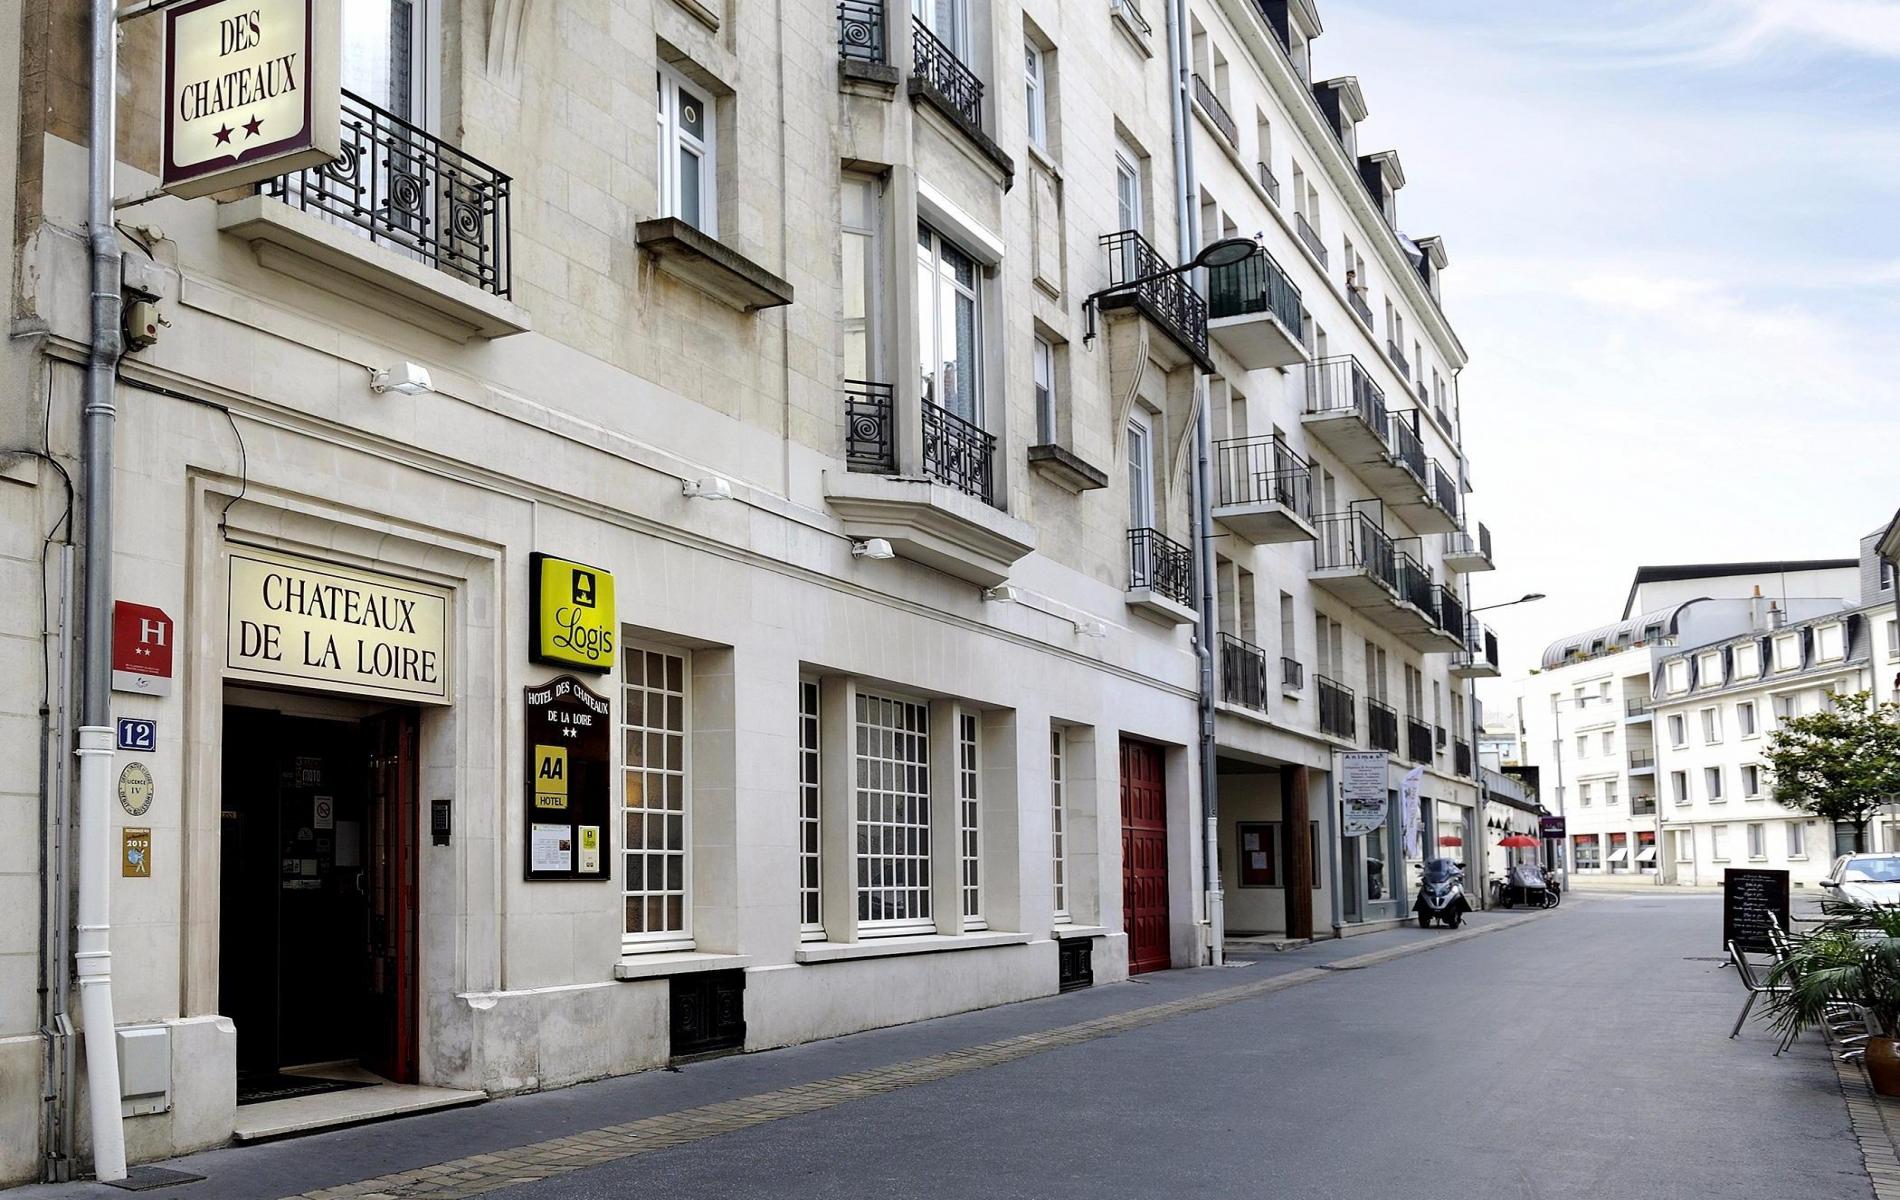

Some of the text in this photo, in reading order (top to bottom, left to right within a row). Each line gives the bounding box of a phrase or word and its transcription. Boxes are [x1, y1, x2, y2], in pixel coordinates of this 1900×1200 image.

[219, 9, 261, 57] DES
[180, 53, 297, 122] CHATEAUX
[262, 573, 416, 634] CHATEAUX
[139, 618, 167, 647] H
[553, 607, 613, 660] Logis
[239, 620, 438, 683] DE LA LOIRE
[528, 681, 609, 715] HOTEL DES CHATEAUX
[548, 710, 593, 726] DE LA LOIRE
[124, 723, 150, 746] 12
[539, 757, 563, 780] AA
[131, 786, 141, 794] IV
[540, 796, 563, 806] HOTEL
[127, 840, 148, 848] 2013
